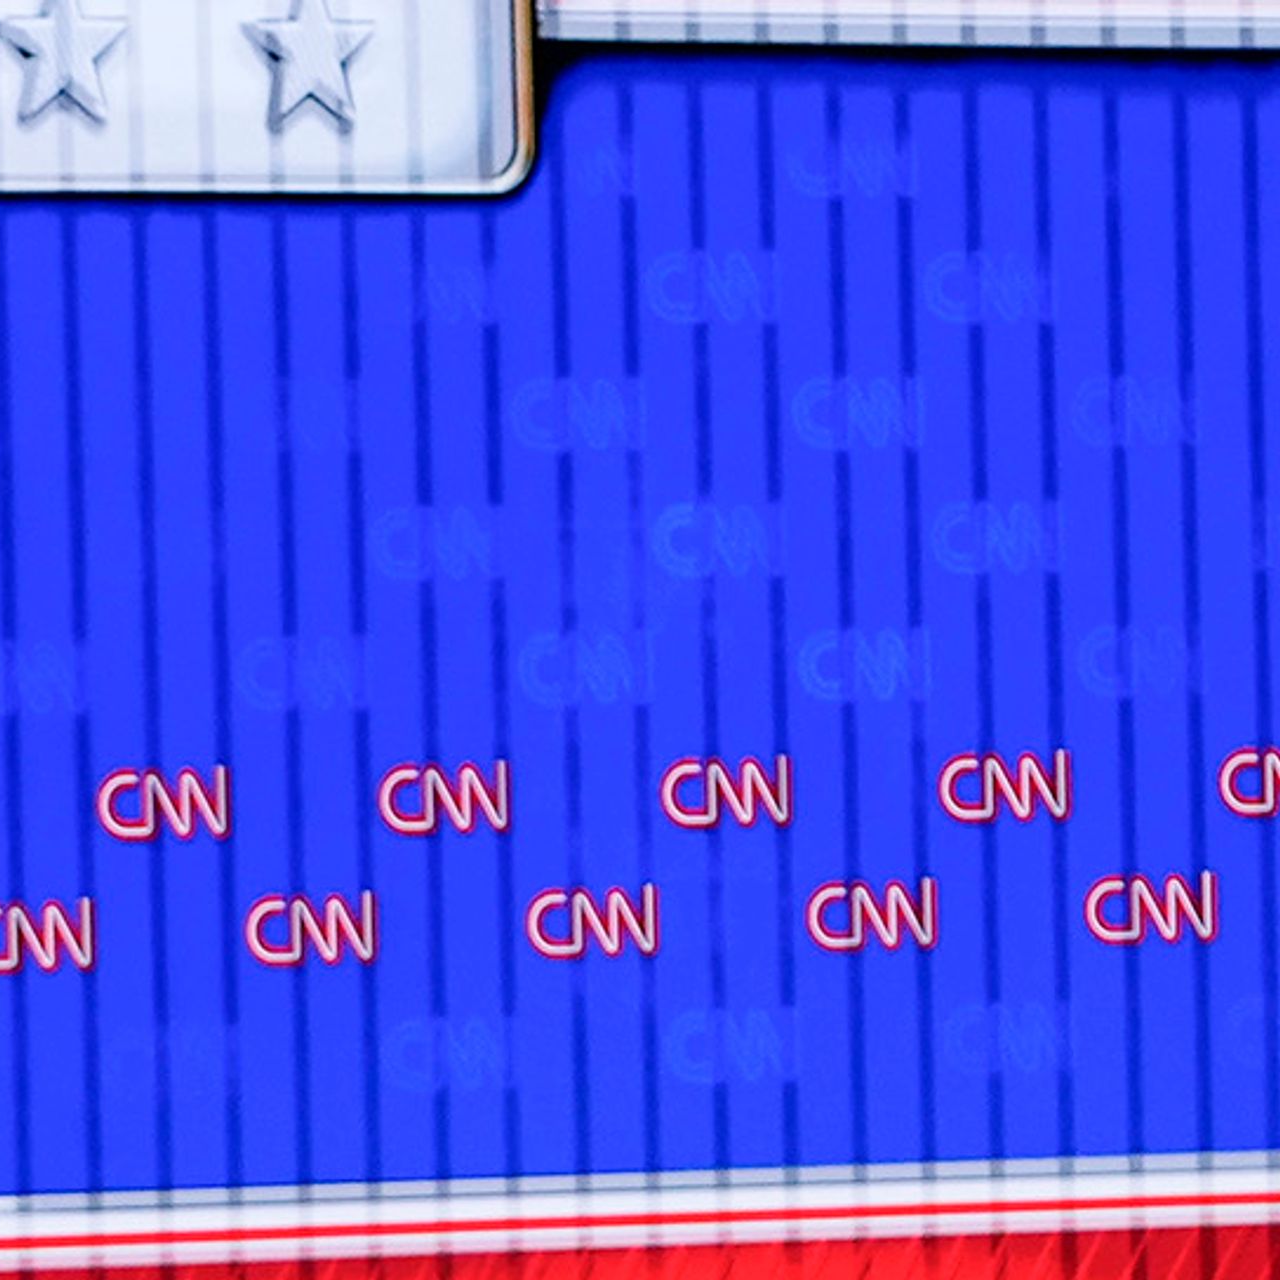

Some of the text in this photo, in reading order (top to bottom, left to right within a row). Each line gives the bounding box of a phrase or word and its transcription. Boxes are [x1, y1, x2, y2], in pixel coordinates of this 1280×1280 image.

[96, 764, 230, 842] CNN
[377, 759, 509, 836] CNN
[658, 754, 793, 829] CNN
[936, 748, 1073, 823] CNN
[244, 890, 379, 968] CNN
[524, 884, 660, 960] CNN
[804, 876, 939, 952] CNN
[1083, 870, 1219, 946] CNN
